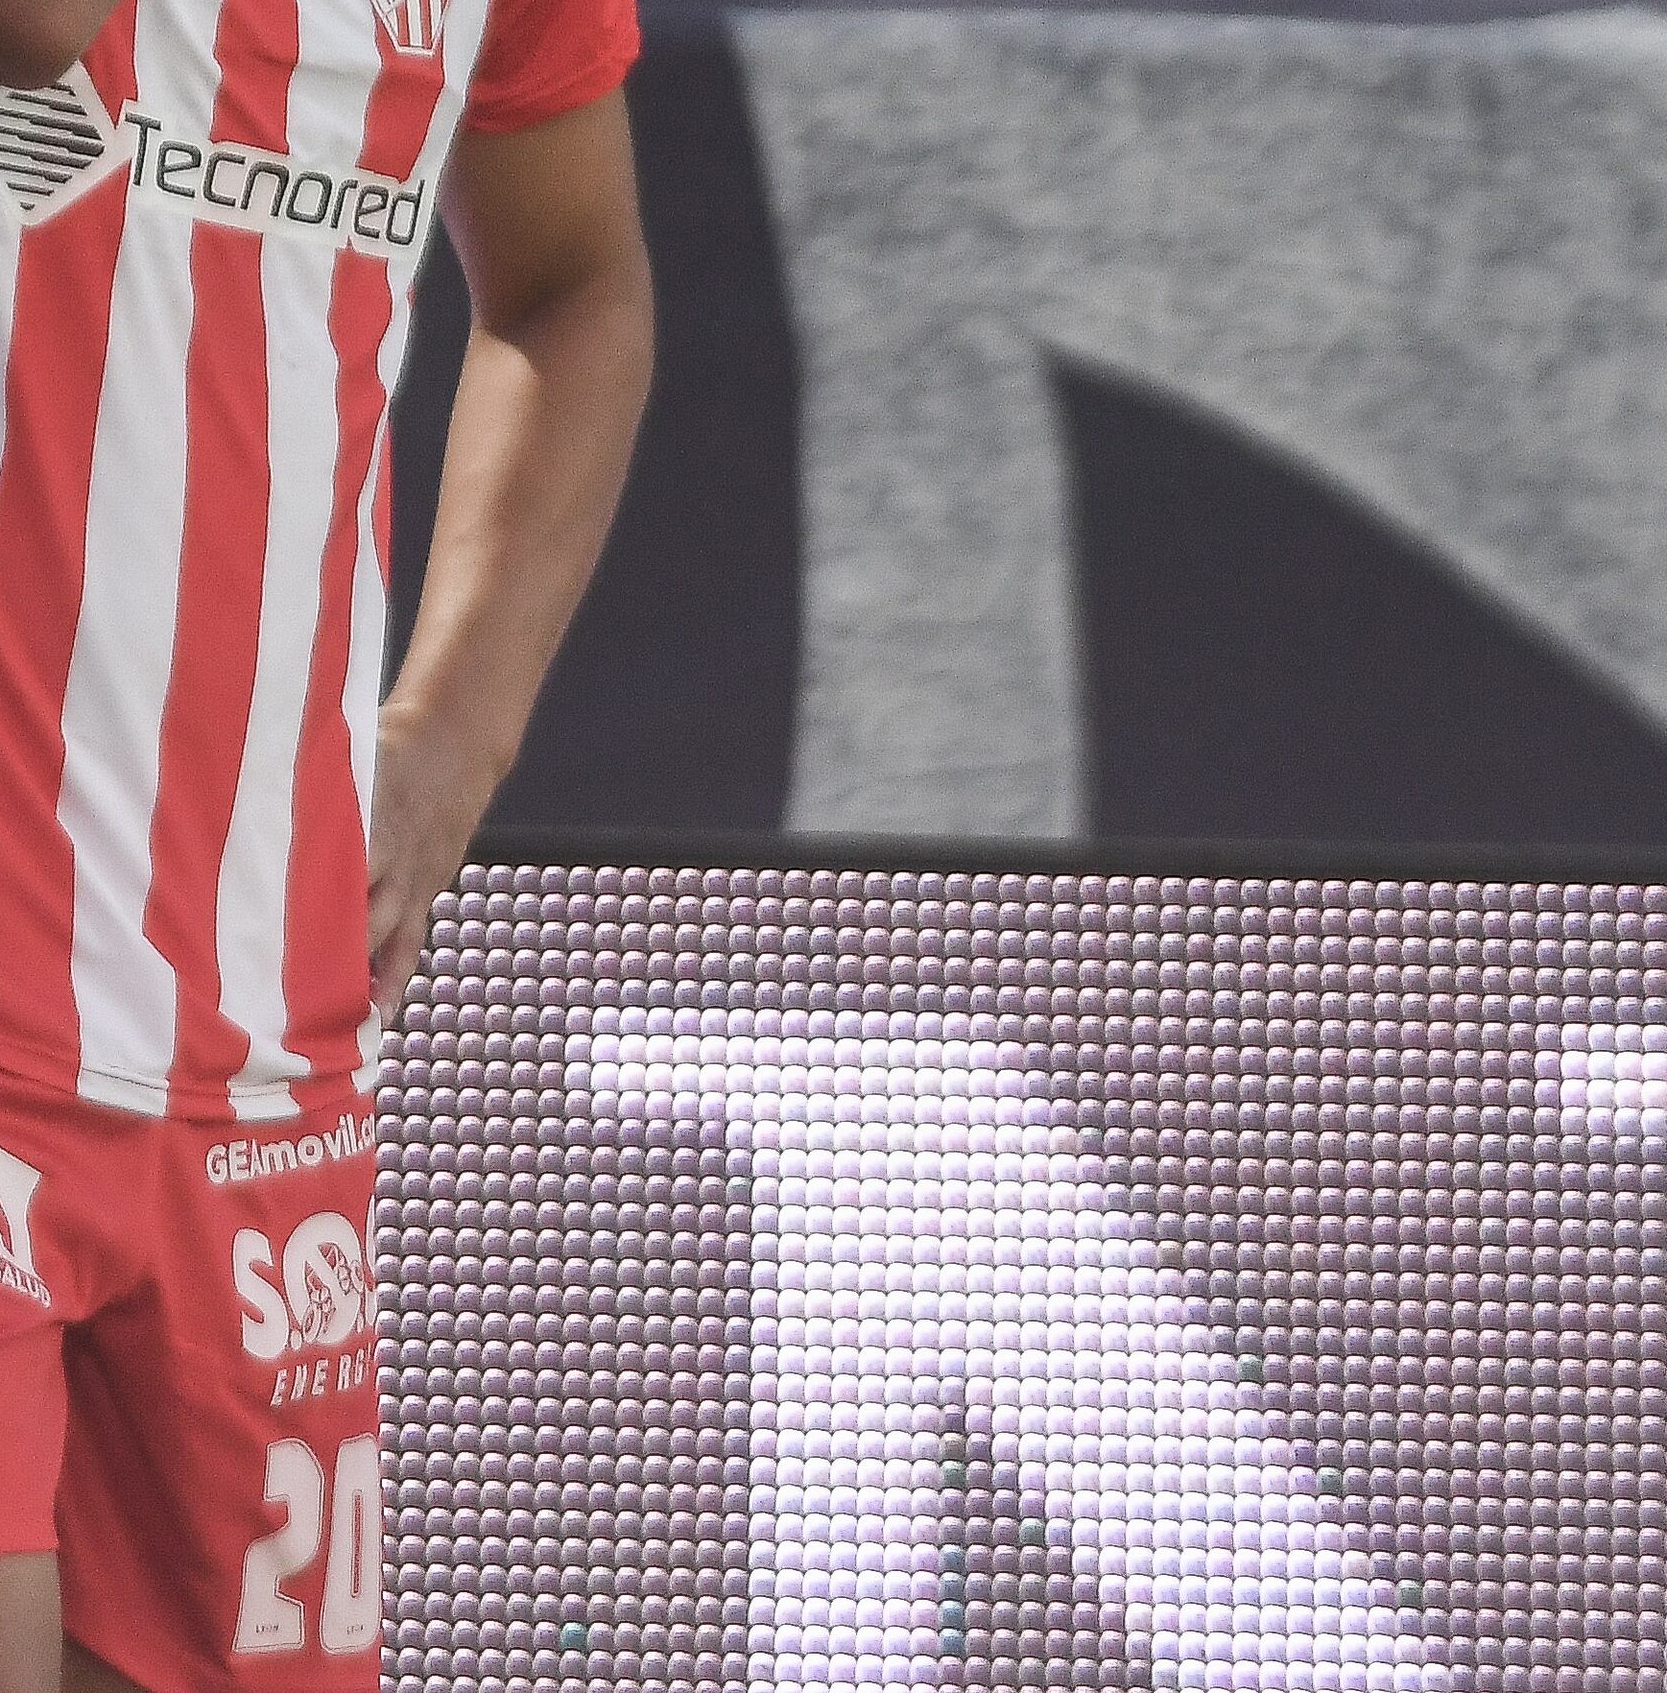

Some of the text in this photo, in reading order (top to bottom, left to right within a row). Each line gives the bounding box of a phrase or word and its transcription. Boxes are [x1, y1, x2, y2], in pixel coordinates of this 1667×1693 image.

[124, 111, 426, 246] Tecnored
[269, 1340, 372, 1408] ENERG
[232, 1431, 384, 1655] 20
